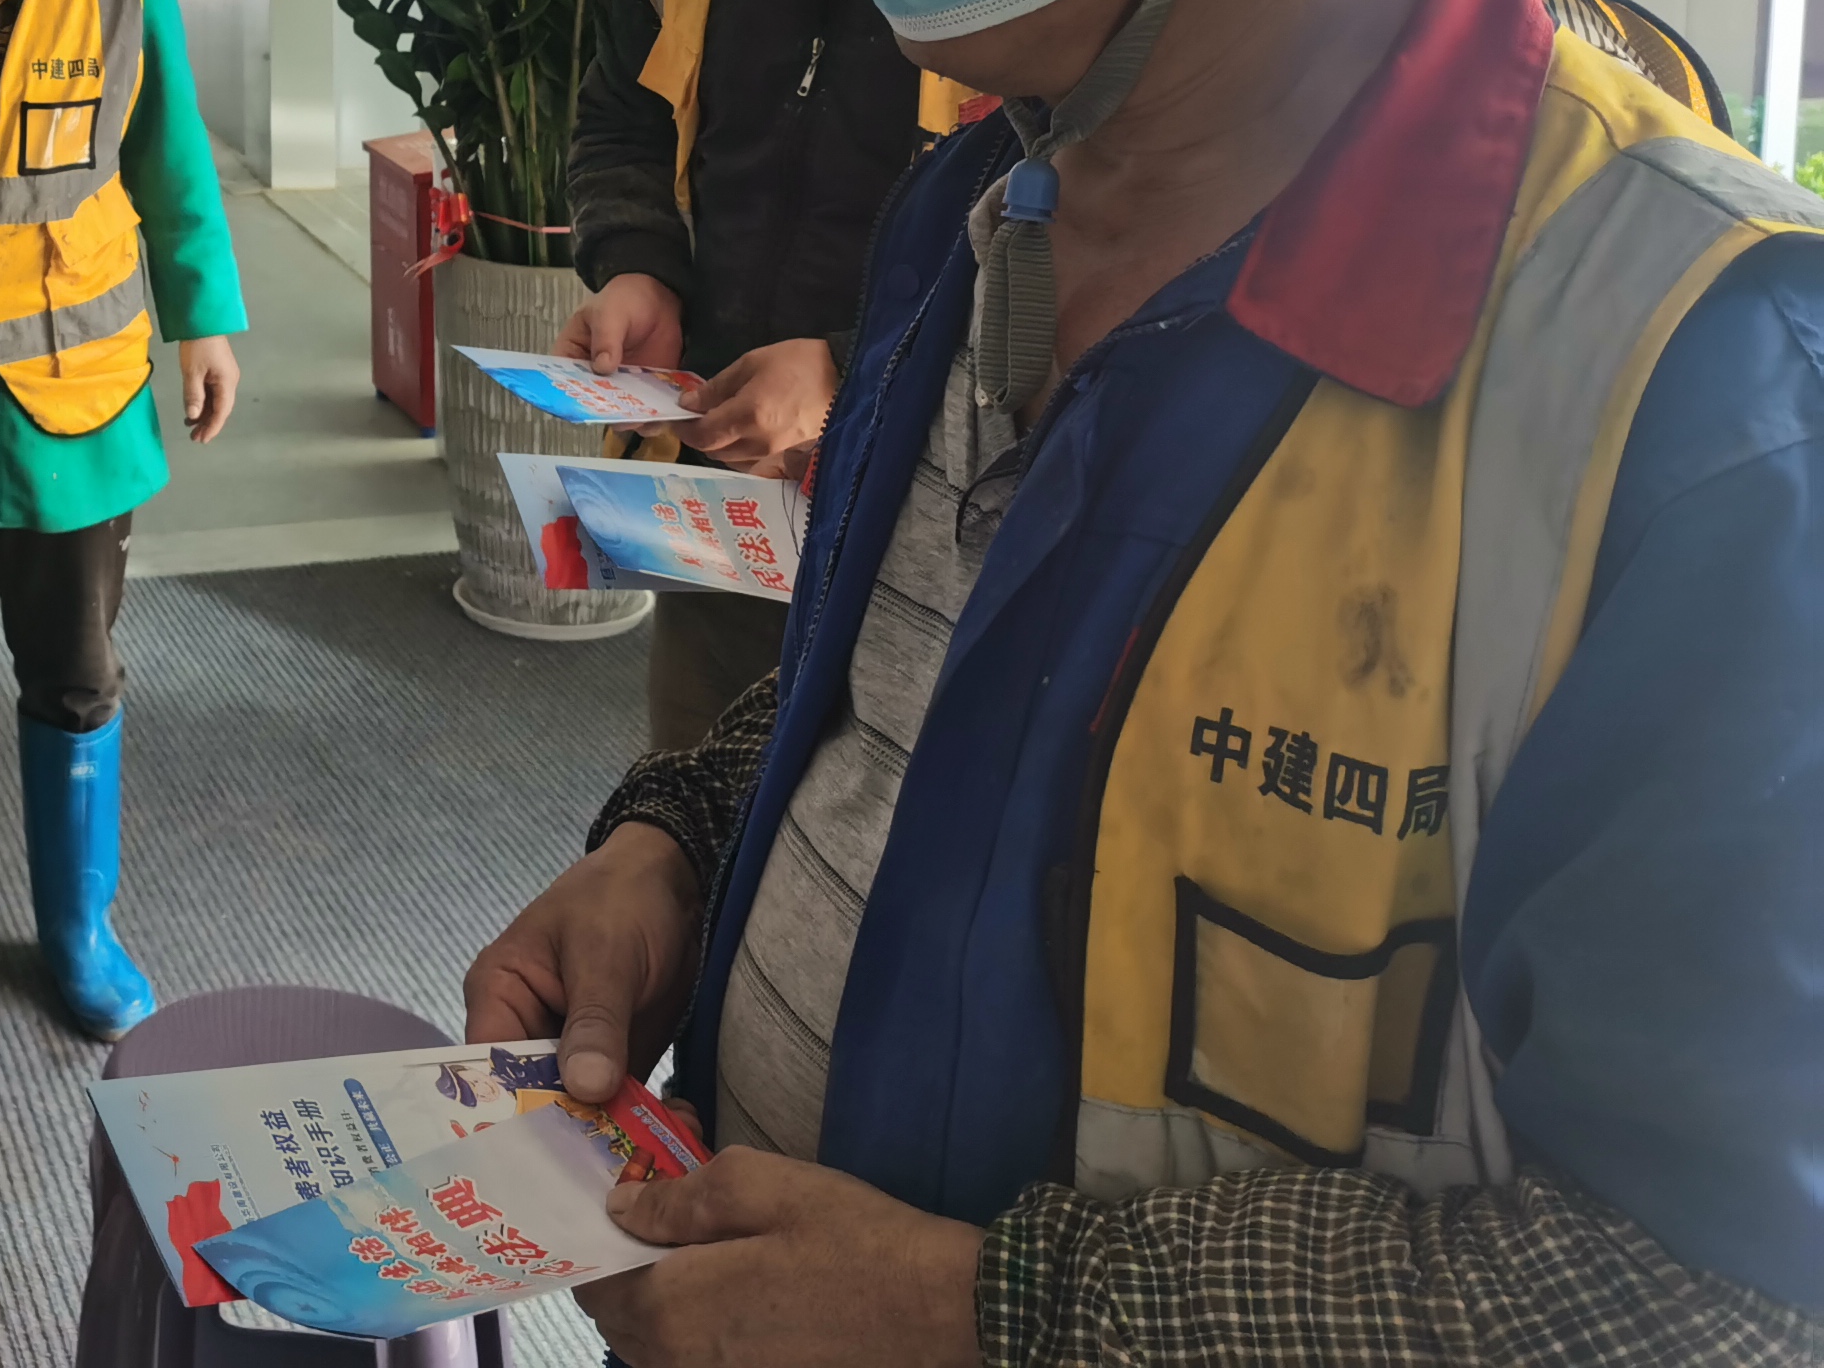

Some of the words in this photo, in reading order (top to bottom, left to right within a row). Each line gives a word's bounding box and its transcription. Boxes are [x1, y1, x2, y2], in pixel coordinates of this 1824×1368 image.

[30, 56, 101, 81] 中建四局
[720, 495, 793, 593] 民法典
[1189, 706, 1452, 842] 中建四局
